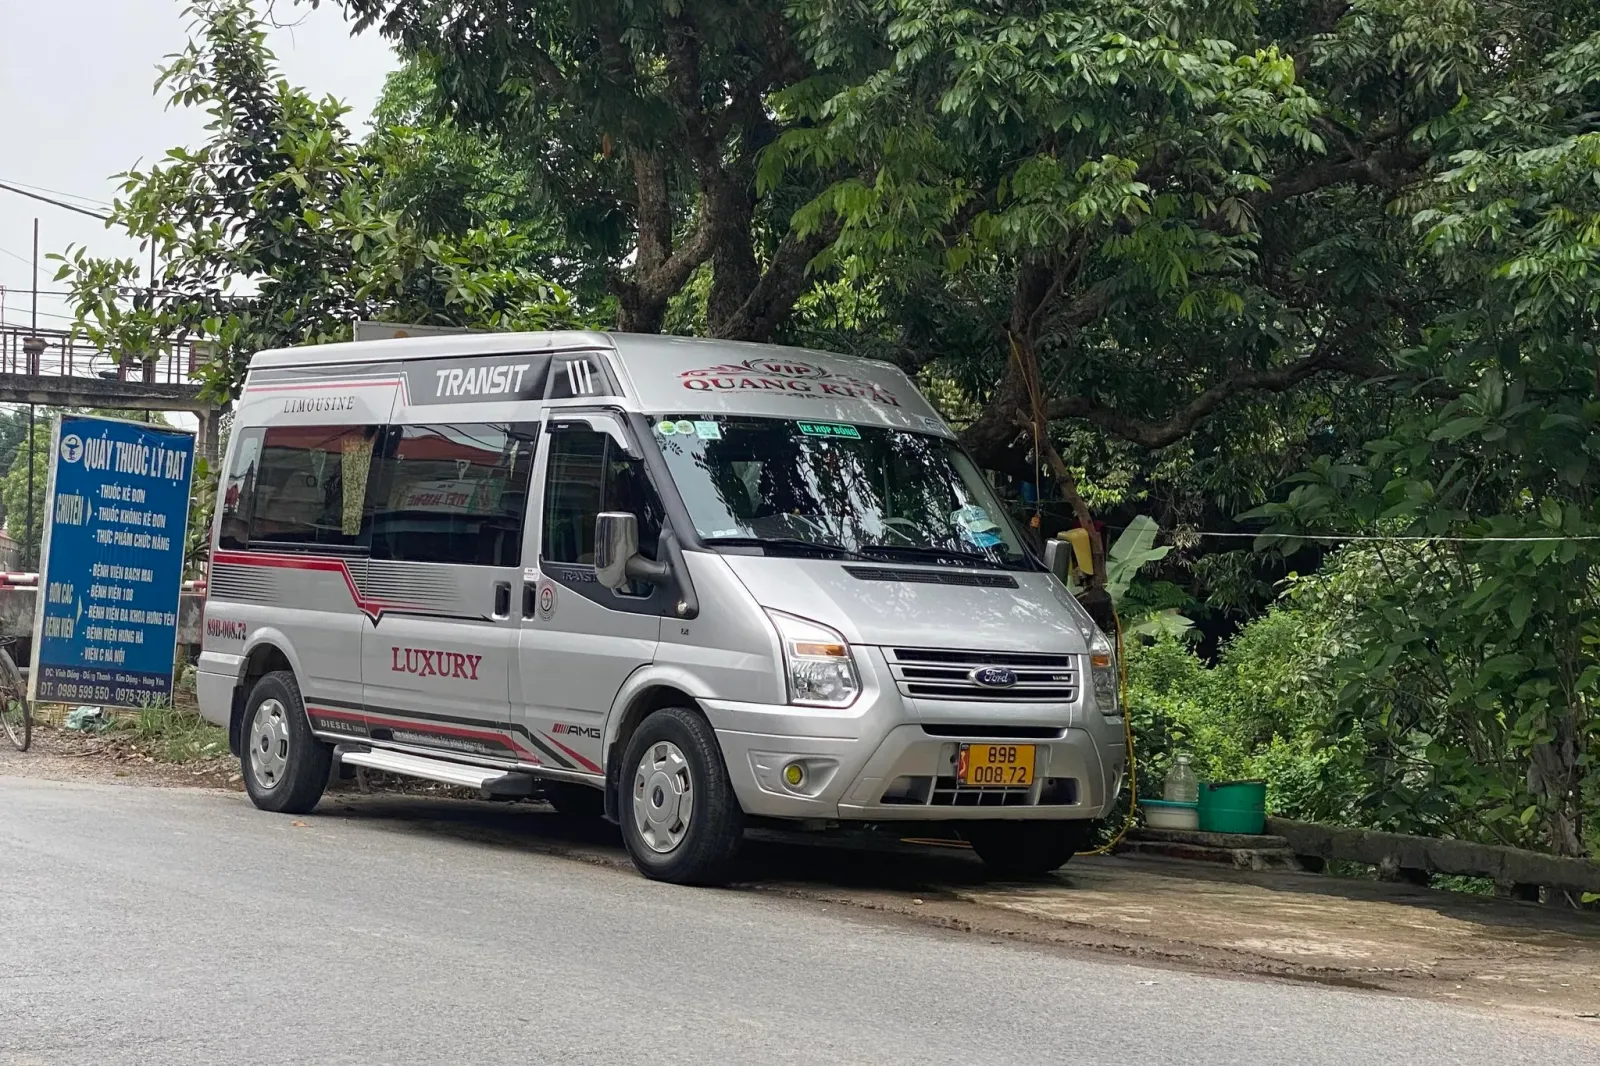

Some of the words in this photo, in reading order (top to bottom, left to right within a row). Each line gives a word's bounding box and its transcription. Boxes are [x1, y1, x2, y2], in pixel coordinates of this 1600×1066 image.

[763, 363, 811, 375] VIP
[435, 363, 530, 397] TRANSIT
[683, 377, 812, 392] QUANG
[283, 395, 356, 414] LIMOUSINE
[115, 434, 149, 477] THUỐC
[150, 442, 165, 478] LÝ
[165, 450, 187, 487] ĐẠT
[100, 481, 122, 500] THUỐC
[99, 503, 120, 522] THUỐC
[120, 507, 142, 525] KHÔNG
[133, 530, 151, 549] CHỨC
[151, 533, 170, 551] NĂNG
[92, 561, 110, 580] BỆNH
[110, 563, 124, 582] VIỆN
[141, 568, 154, 583] MAI
[561, 570, 597, 583] TRANSI
[90, 582, 108, 601] BỆNH
[107, 584, 122, 603] VIỆN
[88, 603, 106, 622] BỆNH
[106, 605, 120, 624] VIỆN
[129, 609, 145, 624] KHOA
[163, 610, 176, 627] YÊN
[86, 624, 103, 642] BỆNH
[103, 626, 117, 644] VIỆN
[206, 618, 247, 641] 89B-008.72
[84, 645, 99, 664] VIỆN
[99, 648, 104, 661] C
[391, 646, 483, 681] LUXURY
[983, 668, 1009, 683] Ford
[57, 683, 77, 698] 0989
[78, 685, 95, 699] 599
[95, 687, 110, 700] 550
[115, 687, 135, 702] 0975
[320, 719, 352, 731] DIESEL
[567, 726, 601, 739] AMG
[988, 746, 1017, 764] 89B
[974, 766, 1027, 784] 008.72
